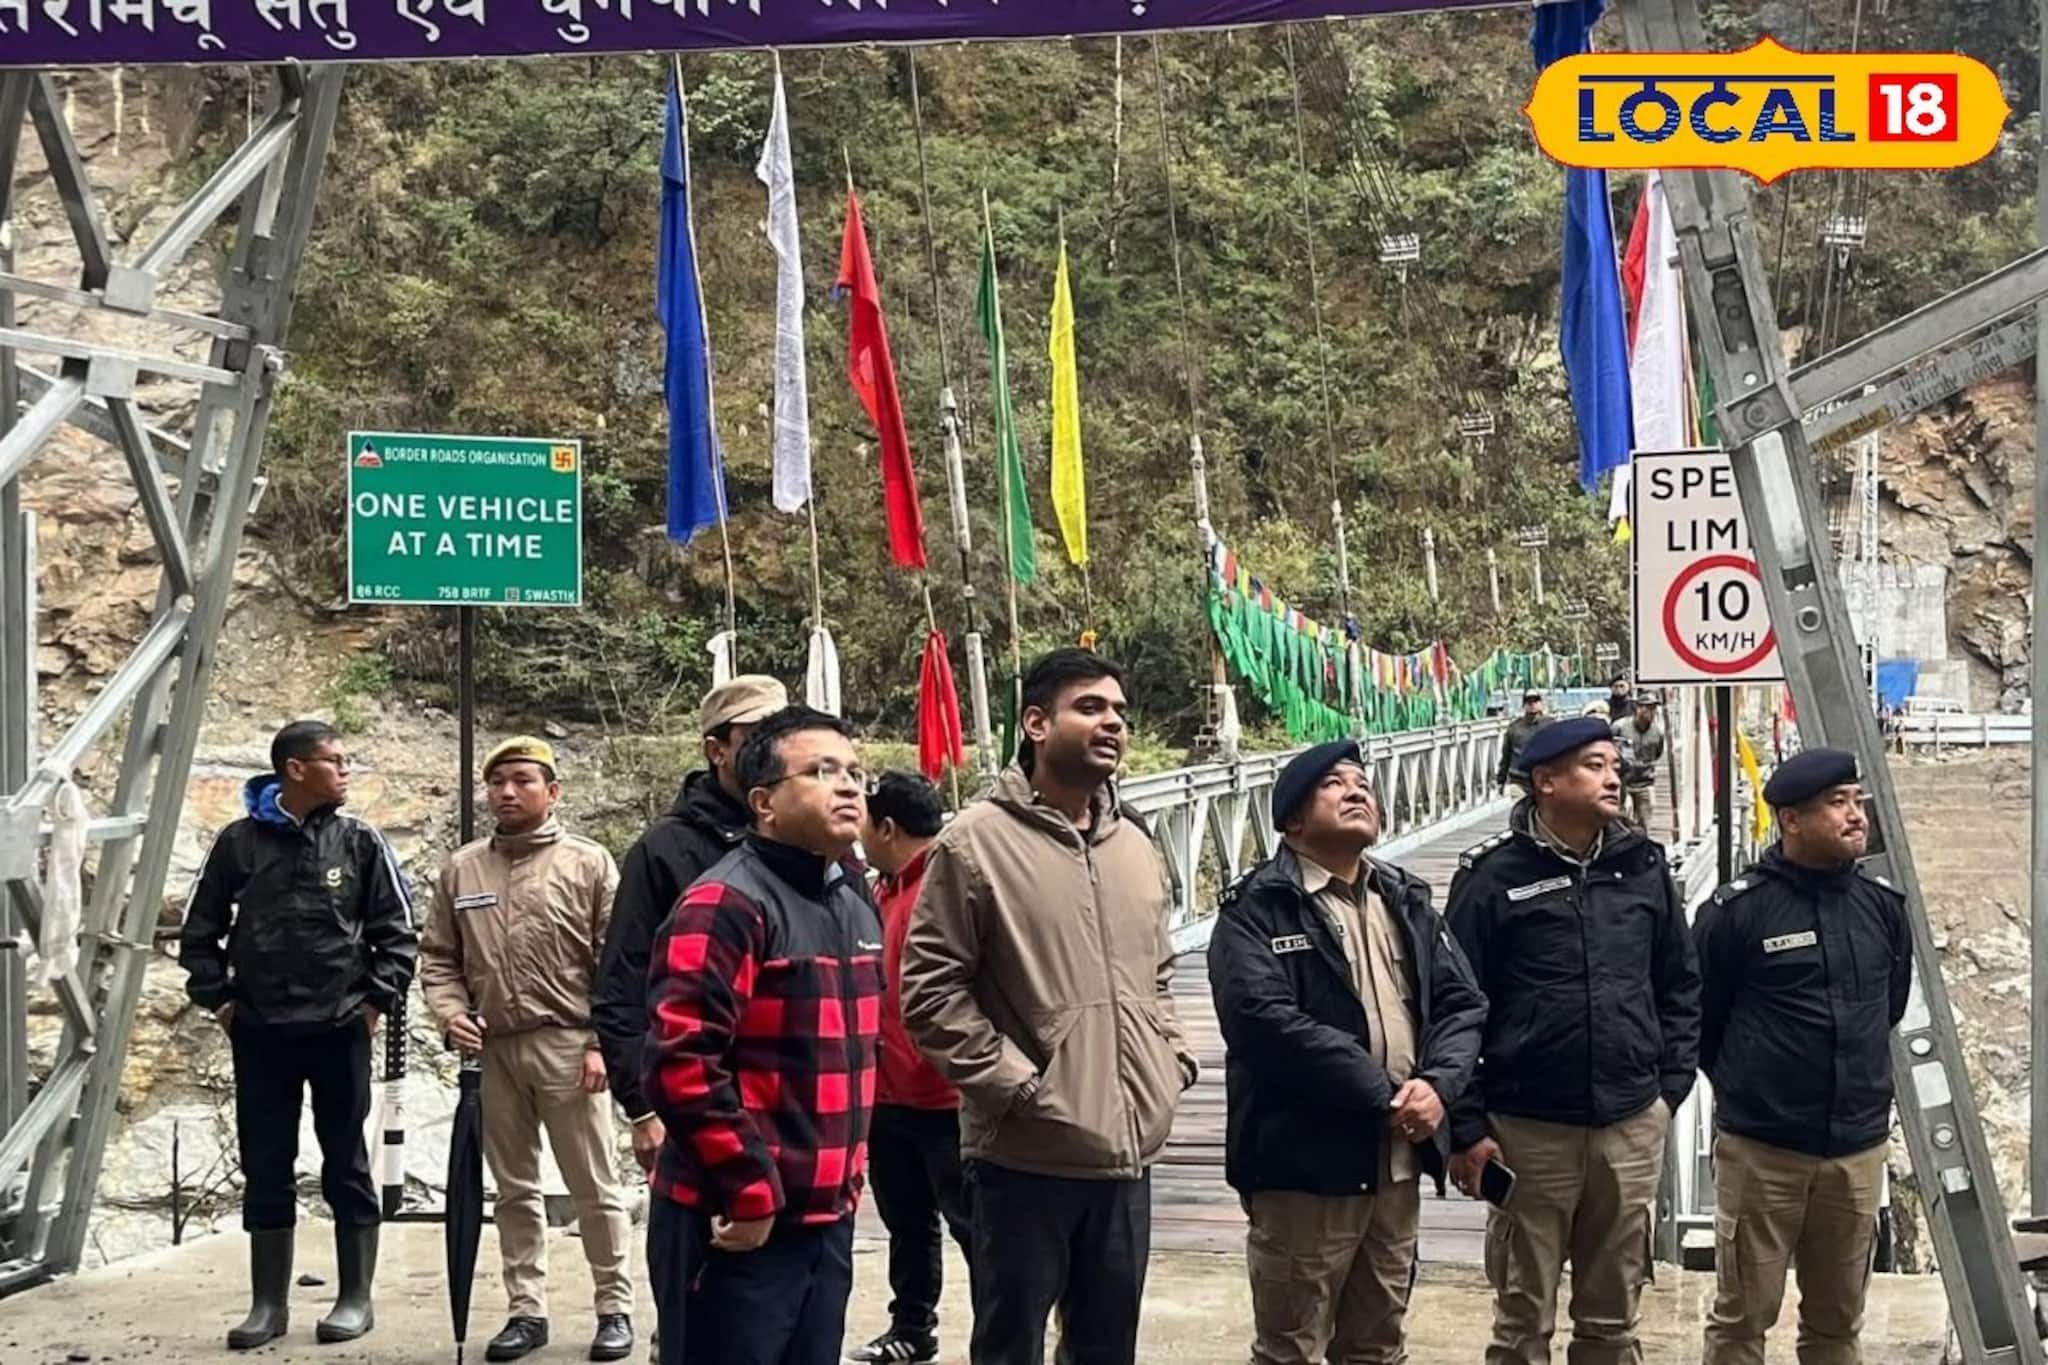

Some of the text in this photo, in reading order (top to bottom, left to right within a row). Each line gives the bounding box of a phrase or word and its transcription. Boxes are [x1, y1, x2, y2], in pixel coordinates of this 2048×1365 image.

[384, 447, 547, 467] BORDER ROADS ORGANISATION
[1650, 466, 1732, 500] SPE
[355, 492, 573, 523] ONE VEHICLE
[387, 531, 543, 559] AT A TIME
[1667, 518, 1753, 551] LIM
[374, 584, 401, 599] RCC
[524, 588, 577, 603] SWASTIK
[1695, 580, 1750, 621] 10
[1696, 632, 1755, 653] KM/H
